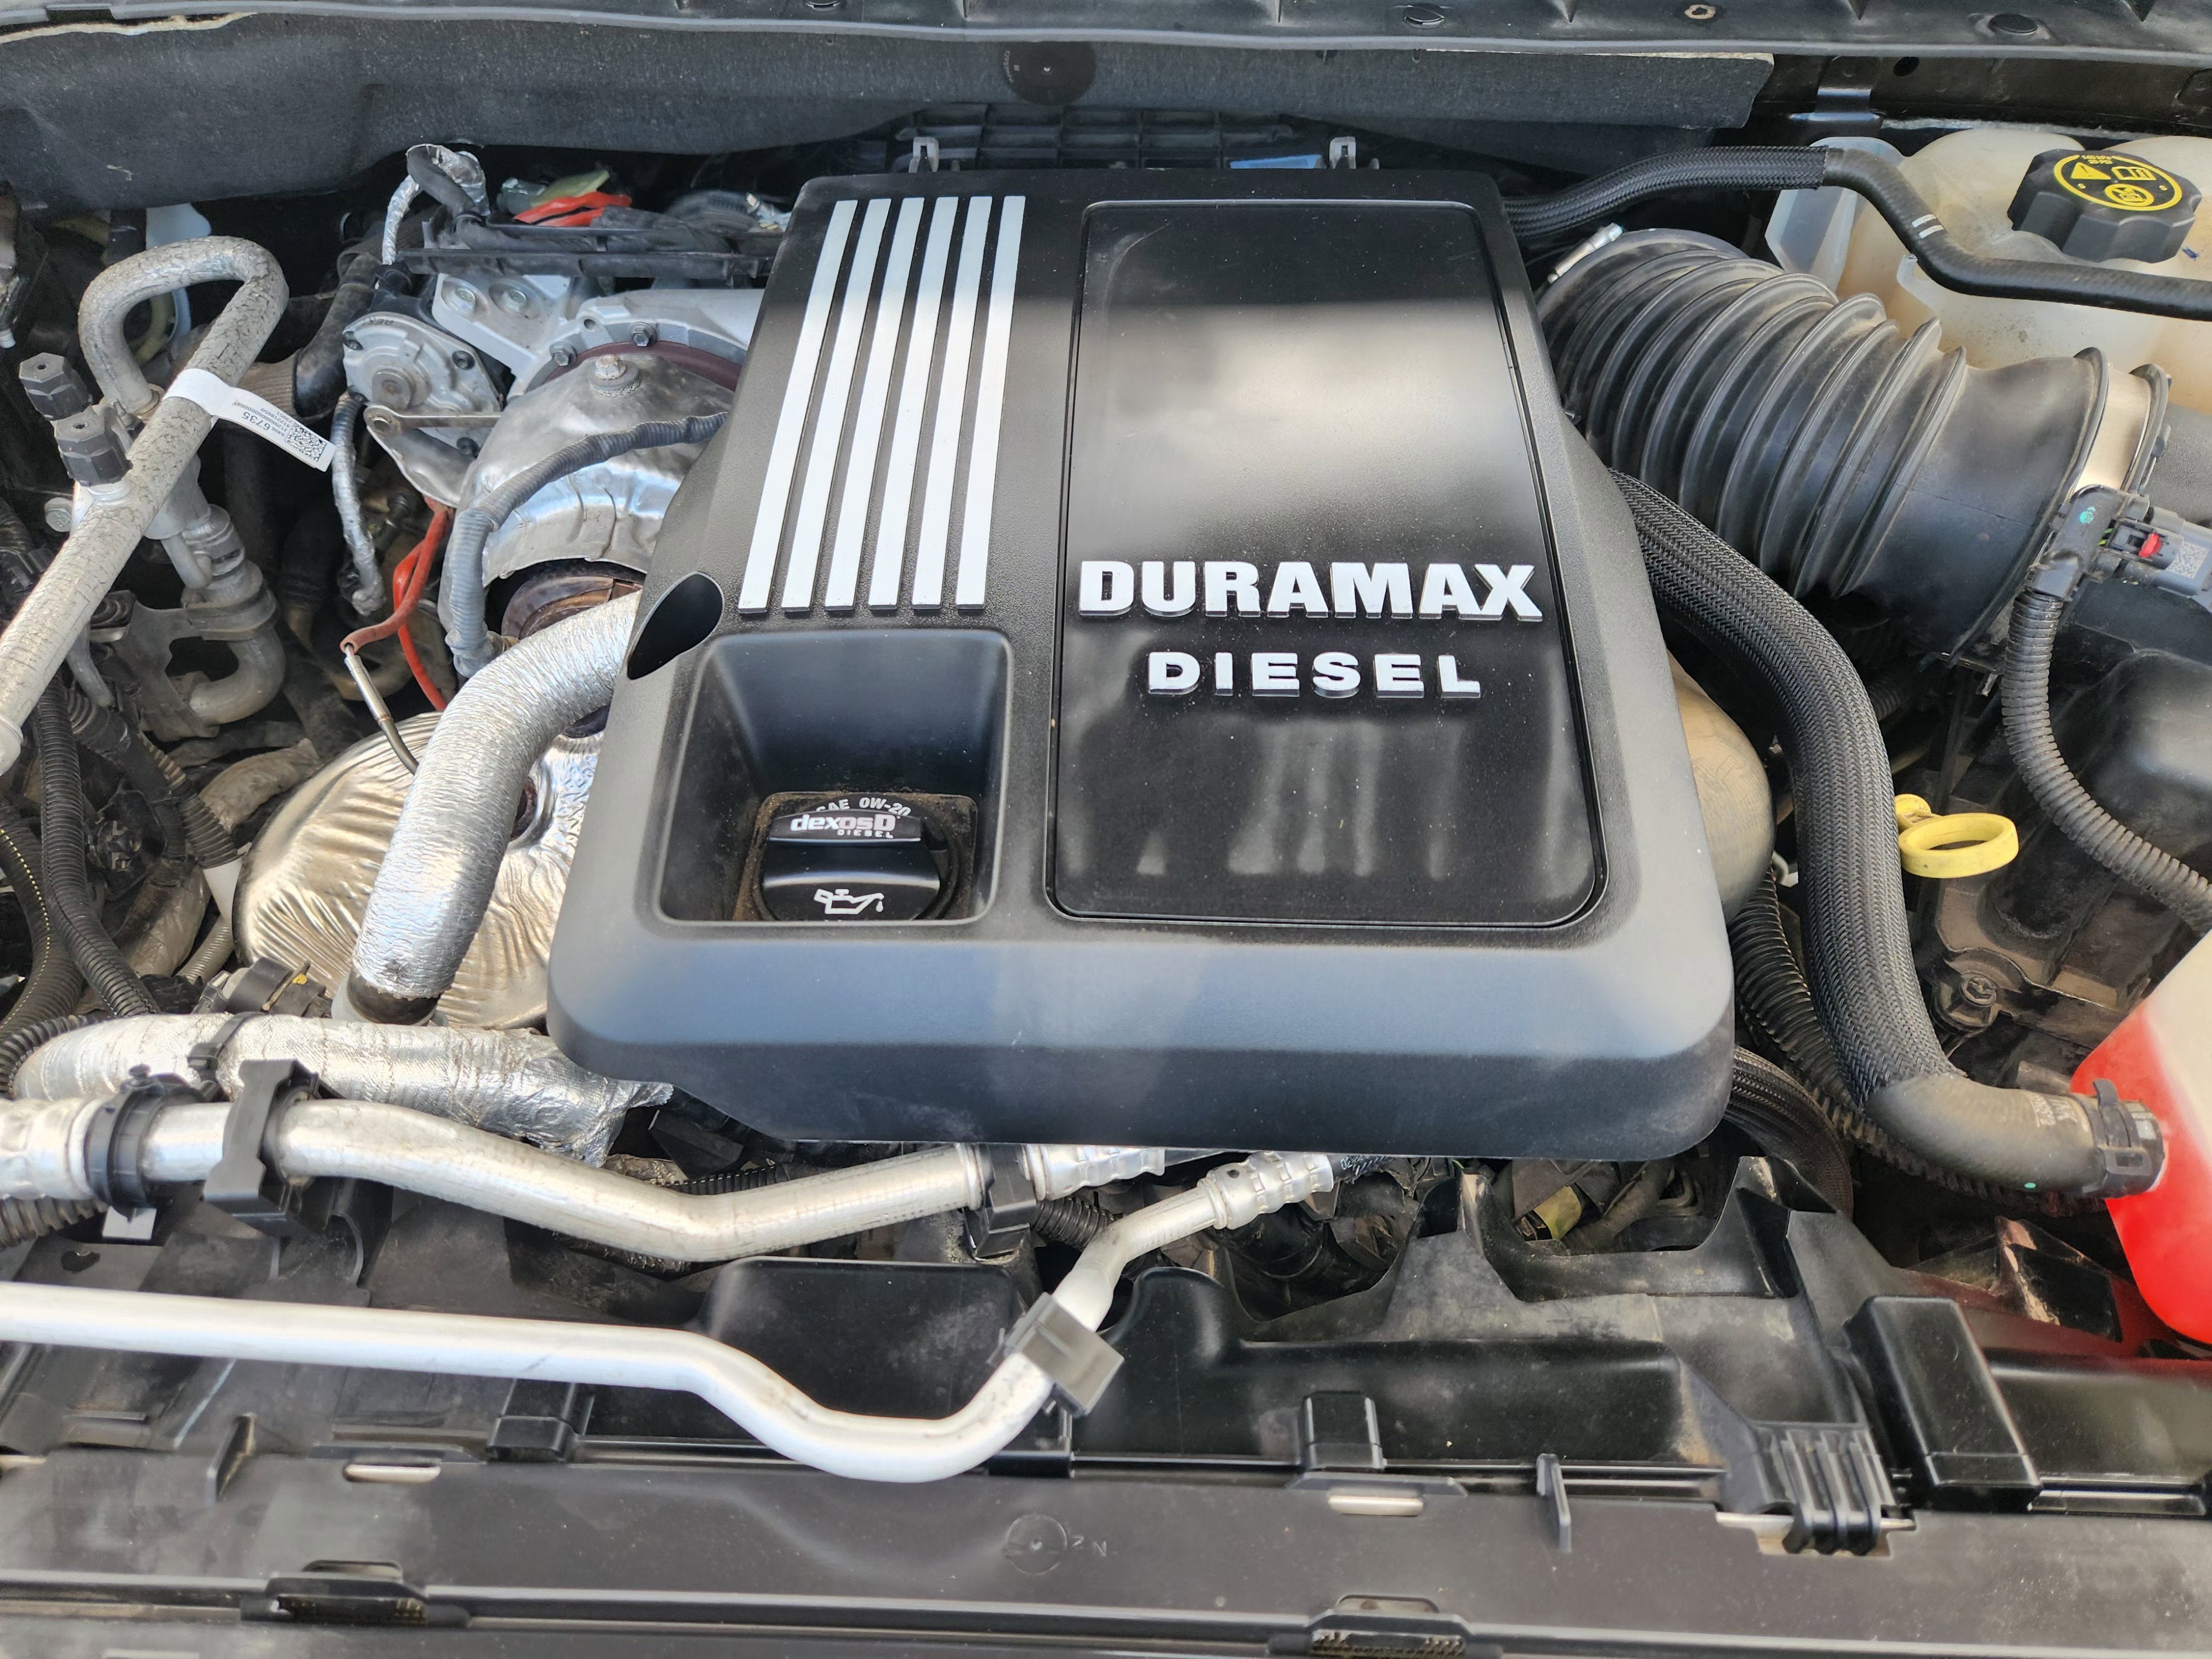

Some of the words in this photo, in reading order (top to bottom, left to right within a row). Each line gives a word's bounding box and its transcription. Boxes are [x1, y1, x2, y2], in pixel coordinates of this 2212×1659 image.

[241, 411, 271, 430] 6735
[1078, 561, 1542, 622] DURAMAX
[1148, 651, 1480, 698] DIESEL
[859, 797, 911, 816] 0W-20
[790, 813, 896, 832] dexosD
[837, 829, 894, 839] DIESEL
